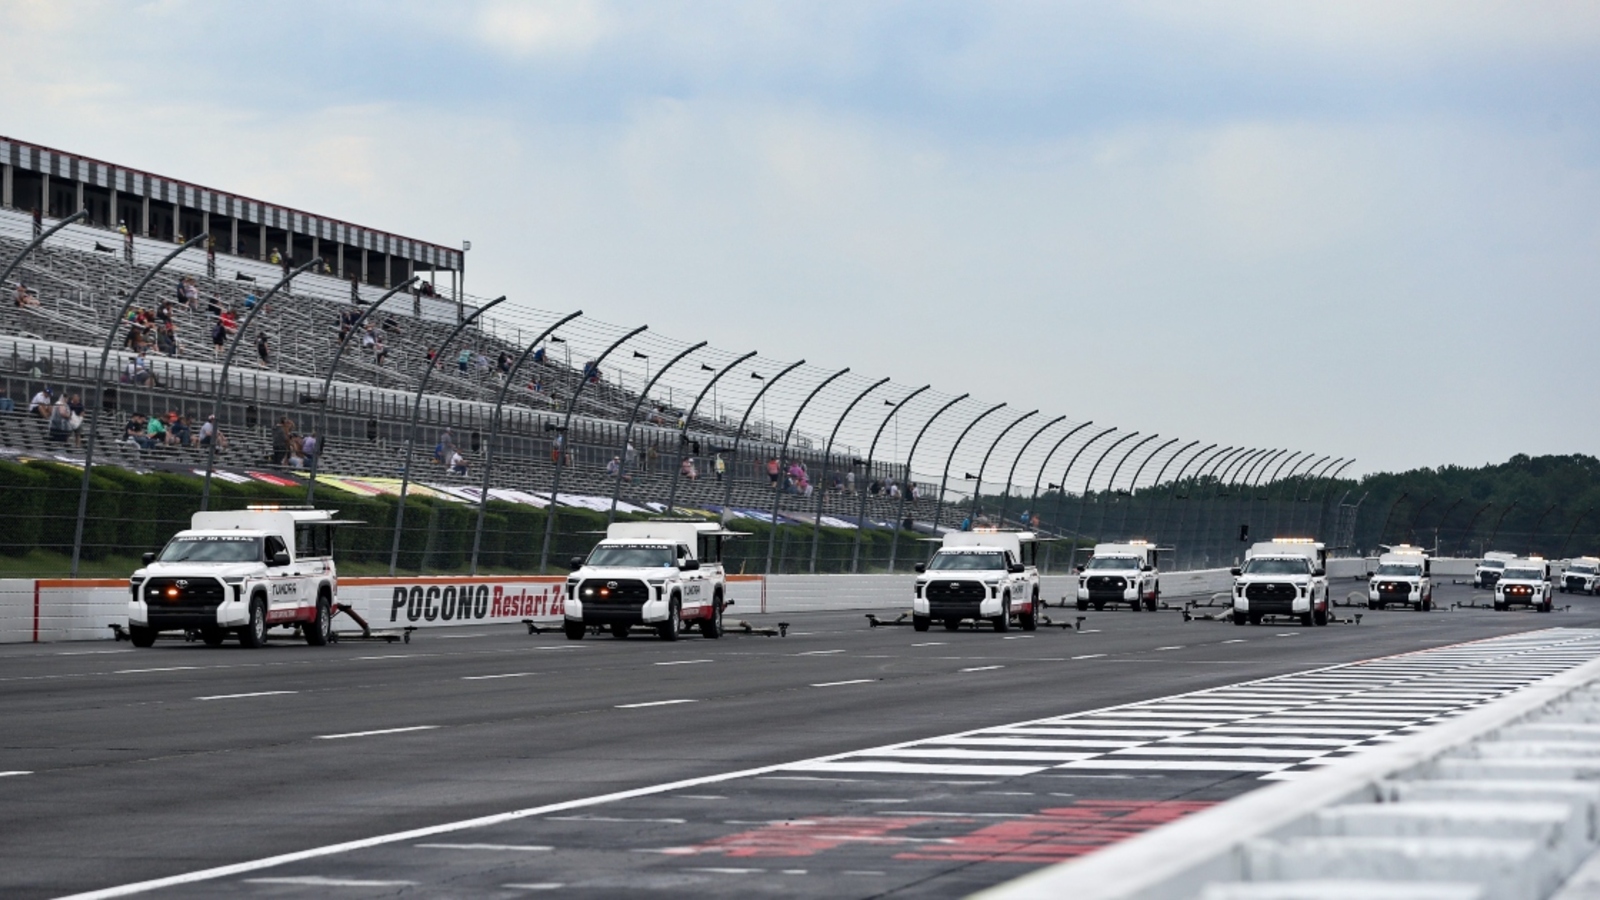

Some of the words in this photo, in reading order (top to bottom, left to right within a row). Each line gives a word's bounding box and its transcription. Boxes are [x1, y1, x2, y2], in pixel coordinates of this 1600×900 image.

[272, 582, 297, 596] TUNDRA
[390, 584, 489, 622] POCONO
[490, 585, 548, 617] Restart
